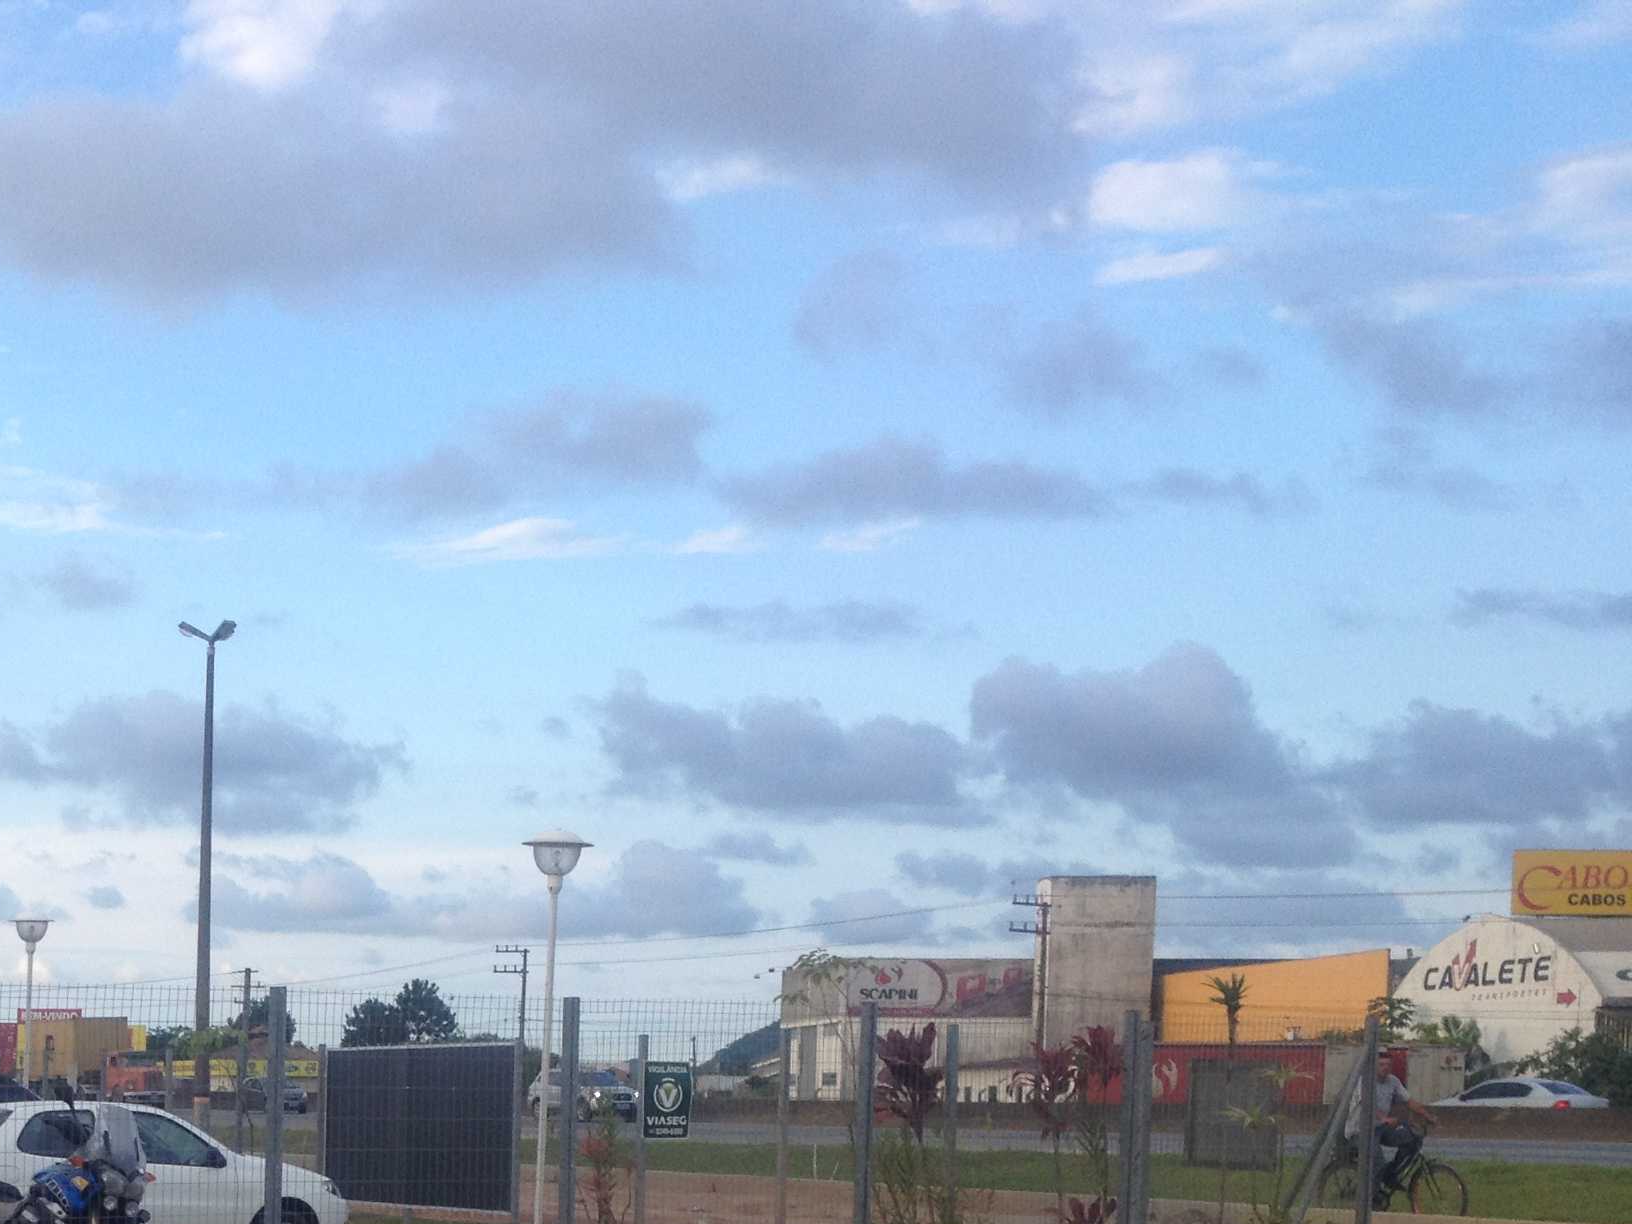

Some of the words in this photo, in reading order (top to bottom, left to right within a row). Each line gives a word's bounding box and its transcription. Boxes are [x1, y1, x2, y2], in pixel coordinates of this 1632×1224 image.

[1567, 893, 1626, 907] CABOS
[1423, 938, 1552, 992] CAVALETE
[859, 987, 919, 1001] SCAPINI
[646, 1115, 688, 1127] VIASEG
